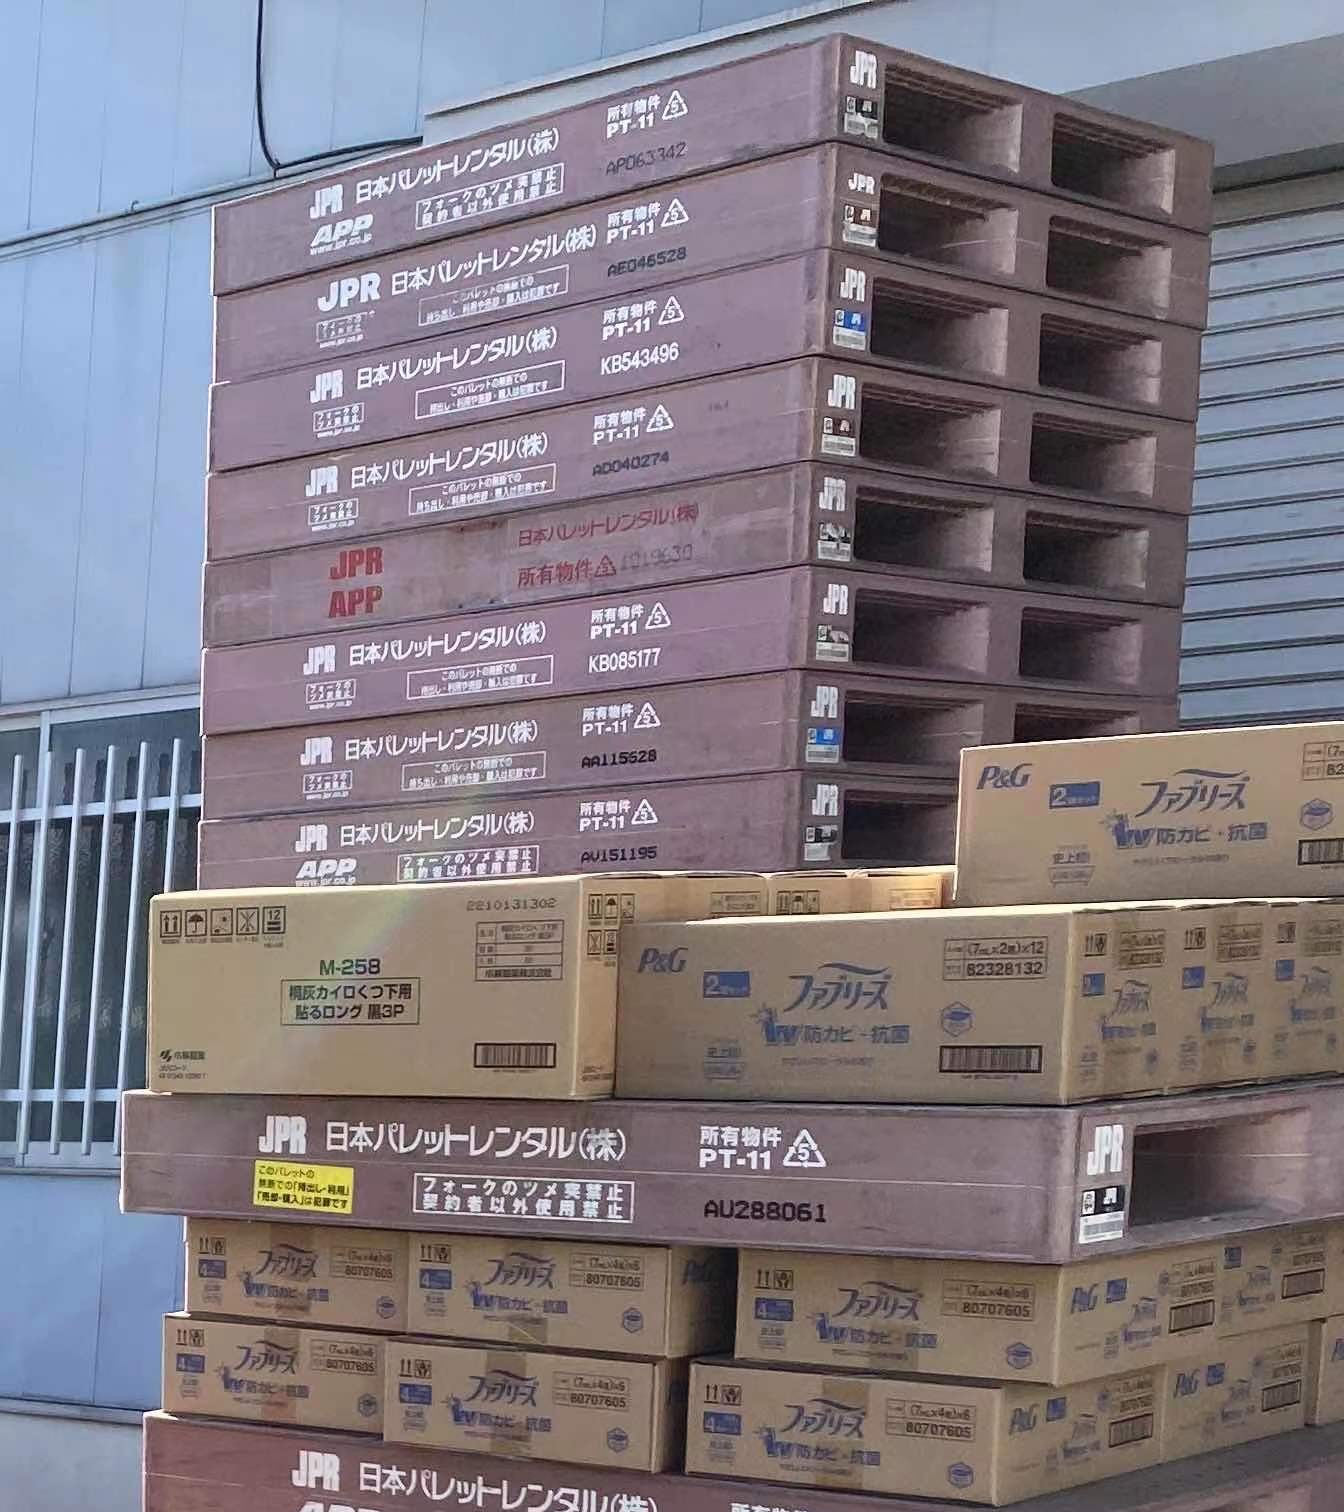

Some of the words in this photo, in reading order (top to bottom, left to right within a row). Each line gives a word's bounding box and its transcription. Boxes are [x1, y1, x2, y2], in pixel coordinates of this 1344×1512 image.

[850, 50, 877, 87] JPR
[608, 95, 660, 123] 所有物件
[607, 113, 655, 138] PT-11
[310, 183, 342, 218] JPR
[355, 127, 559, 203] 日本パレットレンタル(株)
[608, 202, 660, 227] 所有物件
[311, 214, 374, 247] APP
[607, 219, 656, 244] PT-11
[318, 272, 381, 312] JPR
[391, 224, 596, 295] 日本パレットレンタル(株)
[840, 267, 866, 302] JPR
[603, 303, 657, 324] 所有物件
[602, 318, 652, 341] PT-11
[310, 370, 344, 403] JPR
[357, 327, 557, 390] 日本パレットレンタル(株)
[601, 344, 680, 375] KB543496
[593, 408, 646, 429] 所有物件
[593, 425, 640, 445] PT-11
[306, 466, 338, 497] JPR
[352, 432, 547, 489] 日本パレットレンタル(株)
[330, 546, 383, 580] JPR
[518, 558, 593, 588] 所有物件
[328, 585, 383, 618] APP
[591, 604, 644, 623] 所有物件
[590, 620, 637, 639] PT-11
[303, 644, 336, 675] JPR
[350, 620, 546, 666] 日本パレットレンタル(株)
[589, 648, 661, 673] KB085177
[582, 703, 634, 721] 所有物件
[582, 720, 627, 736] PT-11
[301, 736, 333, 765] JPR
[345, 720, 538, 761] 日本パレットレンタル(株)
[977, 763, 1033, 790] P&G
[580, 801, 631, 818] 所有物件
[1135, 776, 1250, 818] ファブリーズ
[296, 824, 328, 853] JPR
[341, 811, 534, 848] 日本パレットレンタル(株)
[580, 816, 625, 831] PT-11
[296, 859, 357, 878] APP
[319, 958, 382, 976] M-258
[638, 947, 689, 974] P&G
[288, 984, 413, 1001] 桐灰カイロくつ下用
[783, 974, 893, 1013] ファブリーズ
[295, 1003, 362, 1021] 貼るロング
[367, 1003, 405, 1020] 黒3P
[259, 1116, 307, 1154] JPR
[327, 1121, 626, 1161] 日本パレットレンタル(株)
[700, 1126, 781, 1148] 所有物件
[1088, 1124, 1124, 1175] JPR
[699, 1148, 772, 1170] PT-11
[704, 1201, 827, 1224] AU288061
[832, 1288, 924, 1321] ファブリーズ
[292, 1450, 340, 1491] JPR
